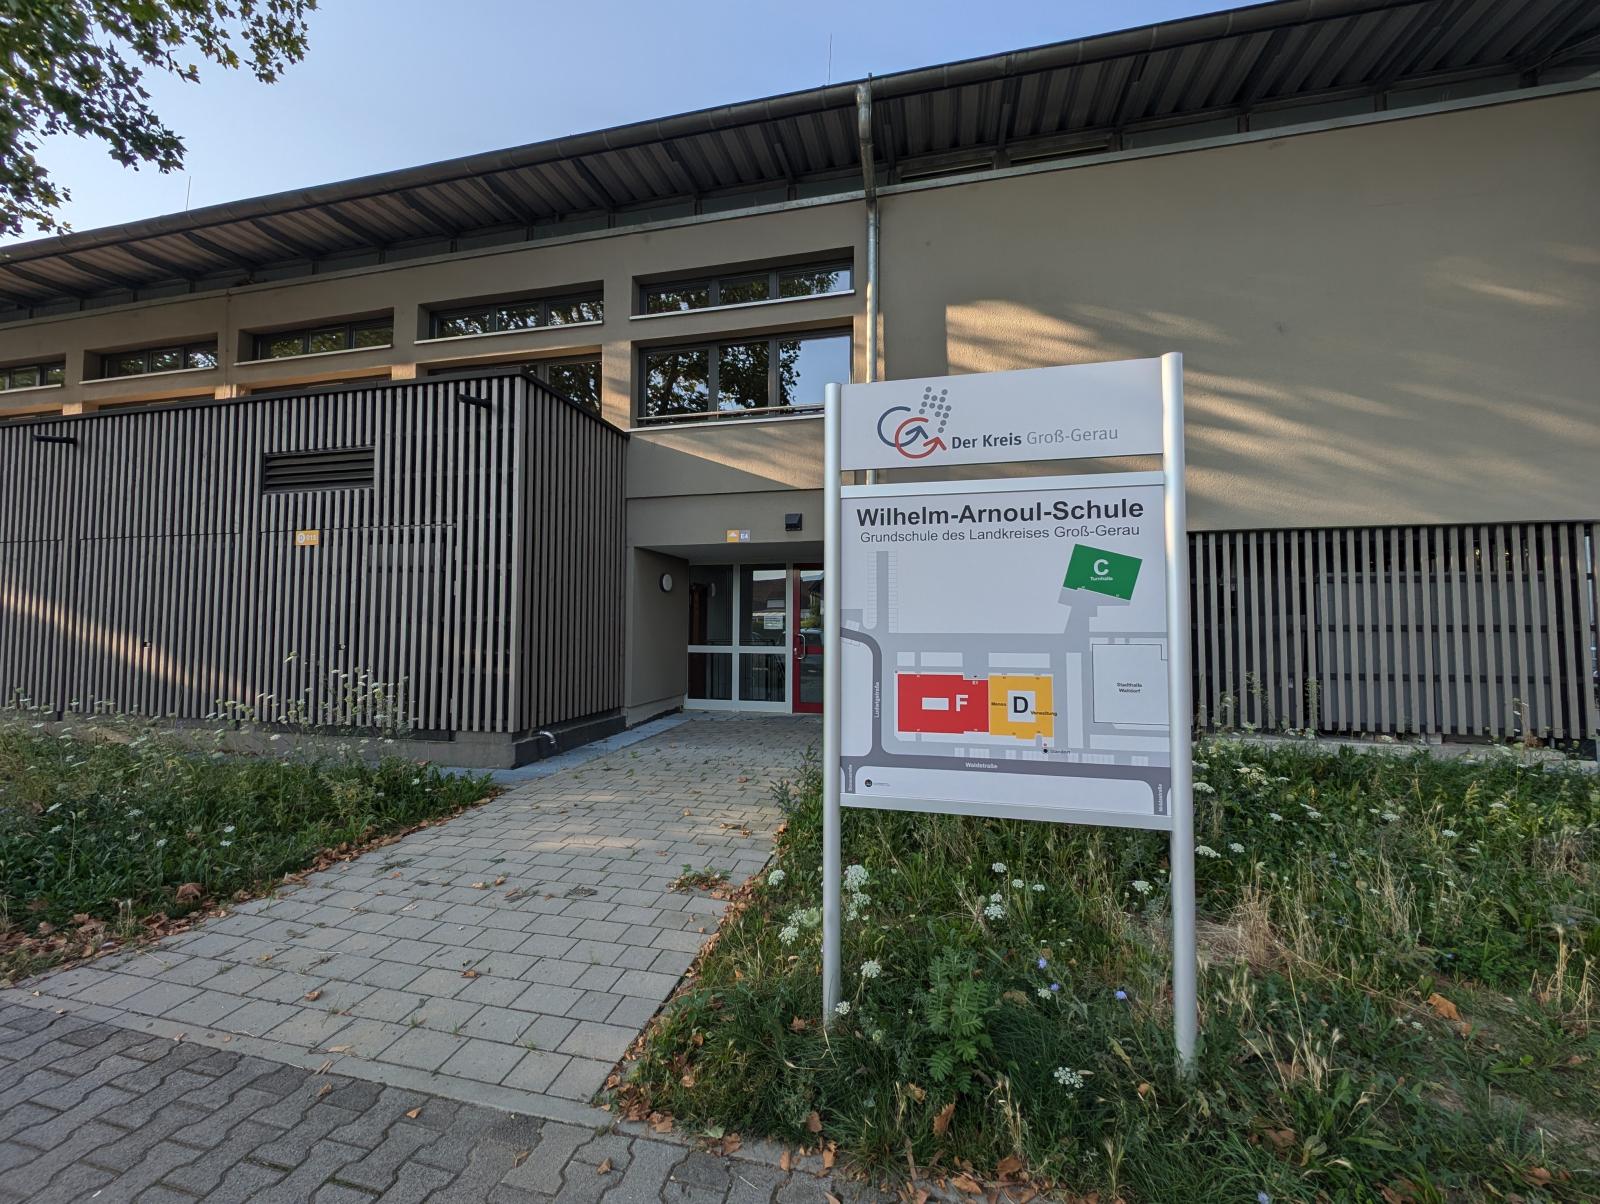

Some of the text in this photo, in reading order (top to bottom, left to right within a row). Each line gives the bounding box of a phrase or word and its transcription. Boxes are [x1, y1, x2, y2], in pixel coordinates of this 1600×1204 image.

[952, 427, 1118, 449] Der Kreis Groß-Gerau
[857, 498, 1144, 527] Wilhelm-Arnoul-Schule
[860, 524, 1140, 543] Grundschule des Landkreises Groß-Gerau
[1093, 558, 1109, 576] C
[955, 694, 969, 712] F
[1013, 695, 1029, 714] D
[965, 761, 999, 769] Waldstraße
